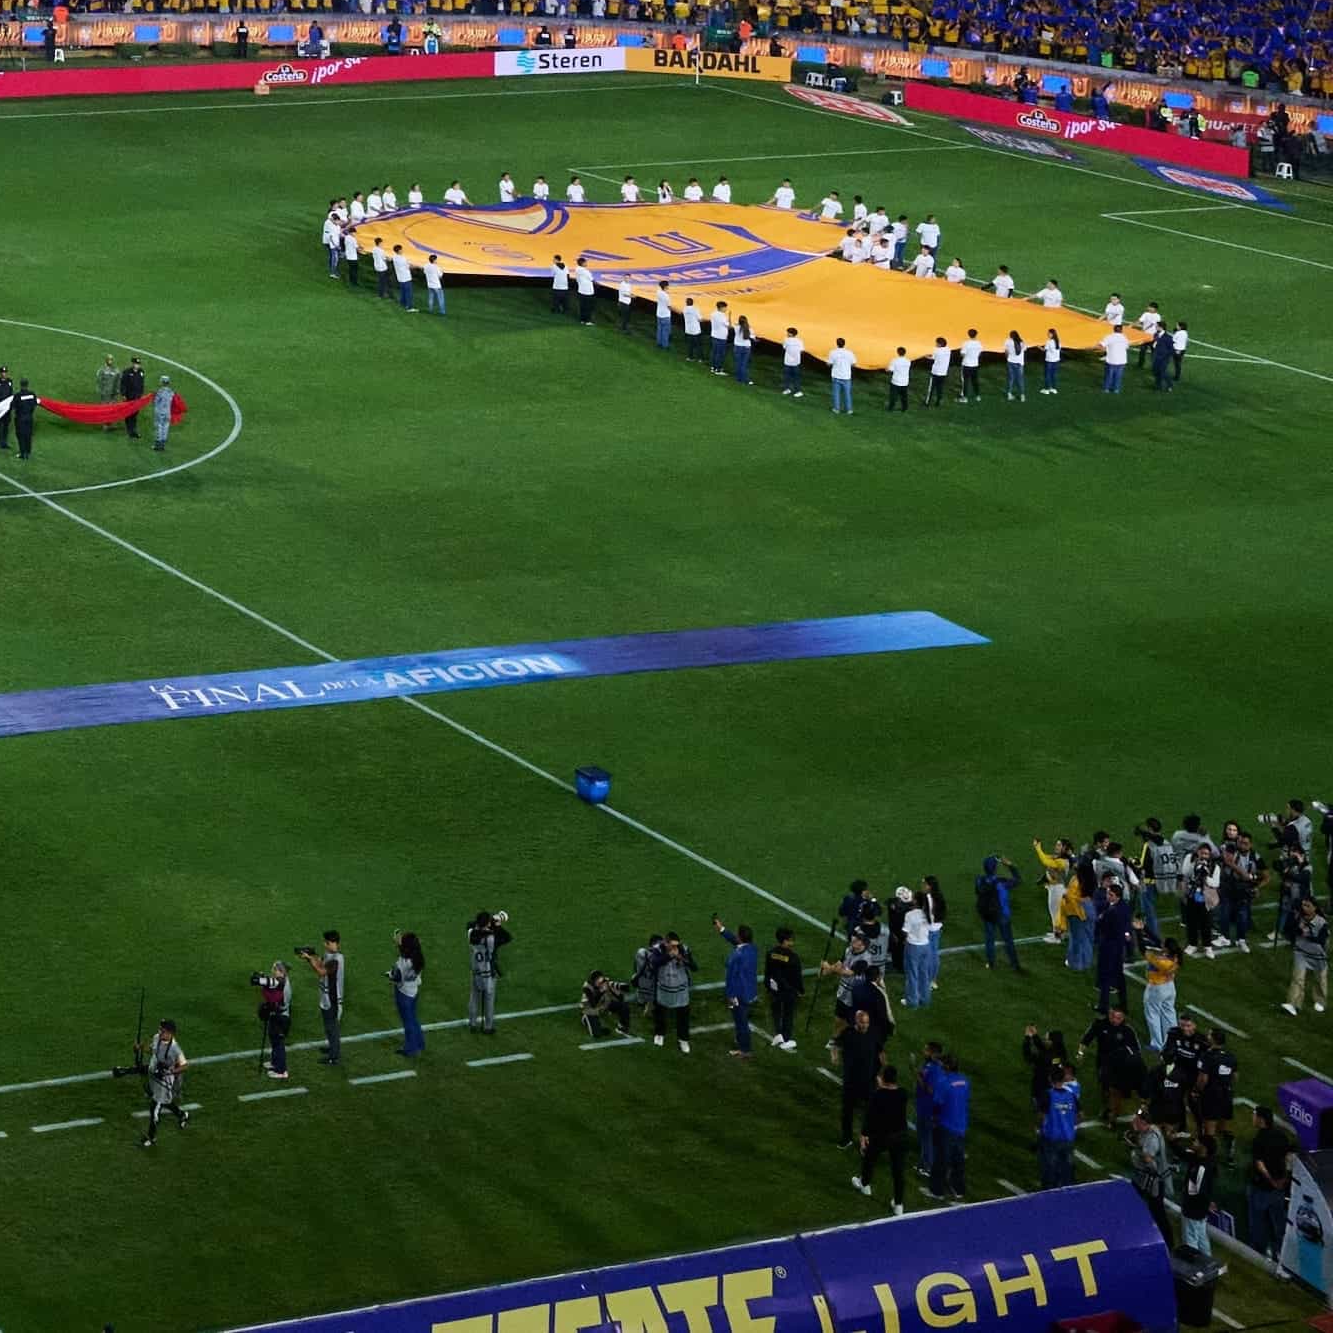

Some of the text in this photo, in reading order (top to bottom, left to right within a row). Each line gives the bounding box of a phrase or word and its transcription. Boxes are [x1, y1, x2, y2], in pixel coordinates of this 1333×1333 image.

[539, 51, 602, 69] Steren
[160, 680, 325, 711] FINAL
[812, 1239, 1110, 1333] LIGHT
